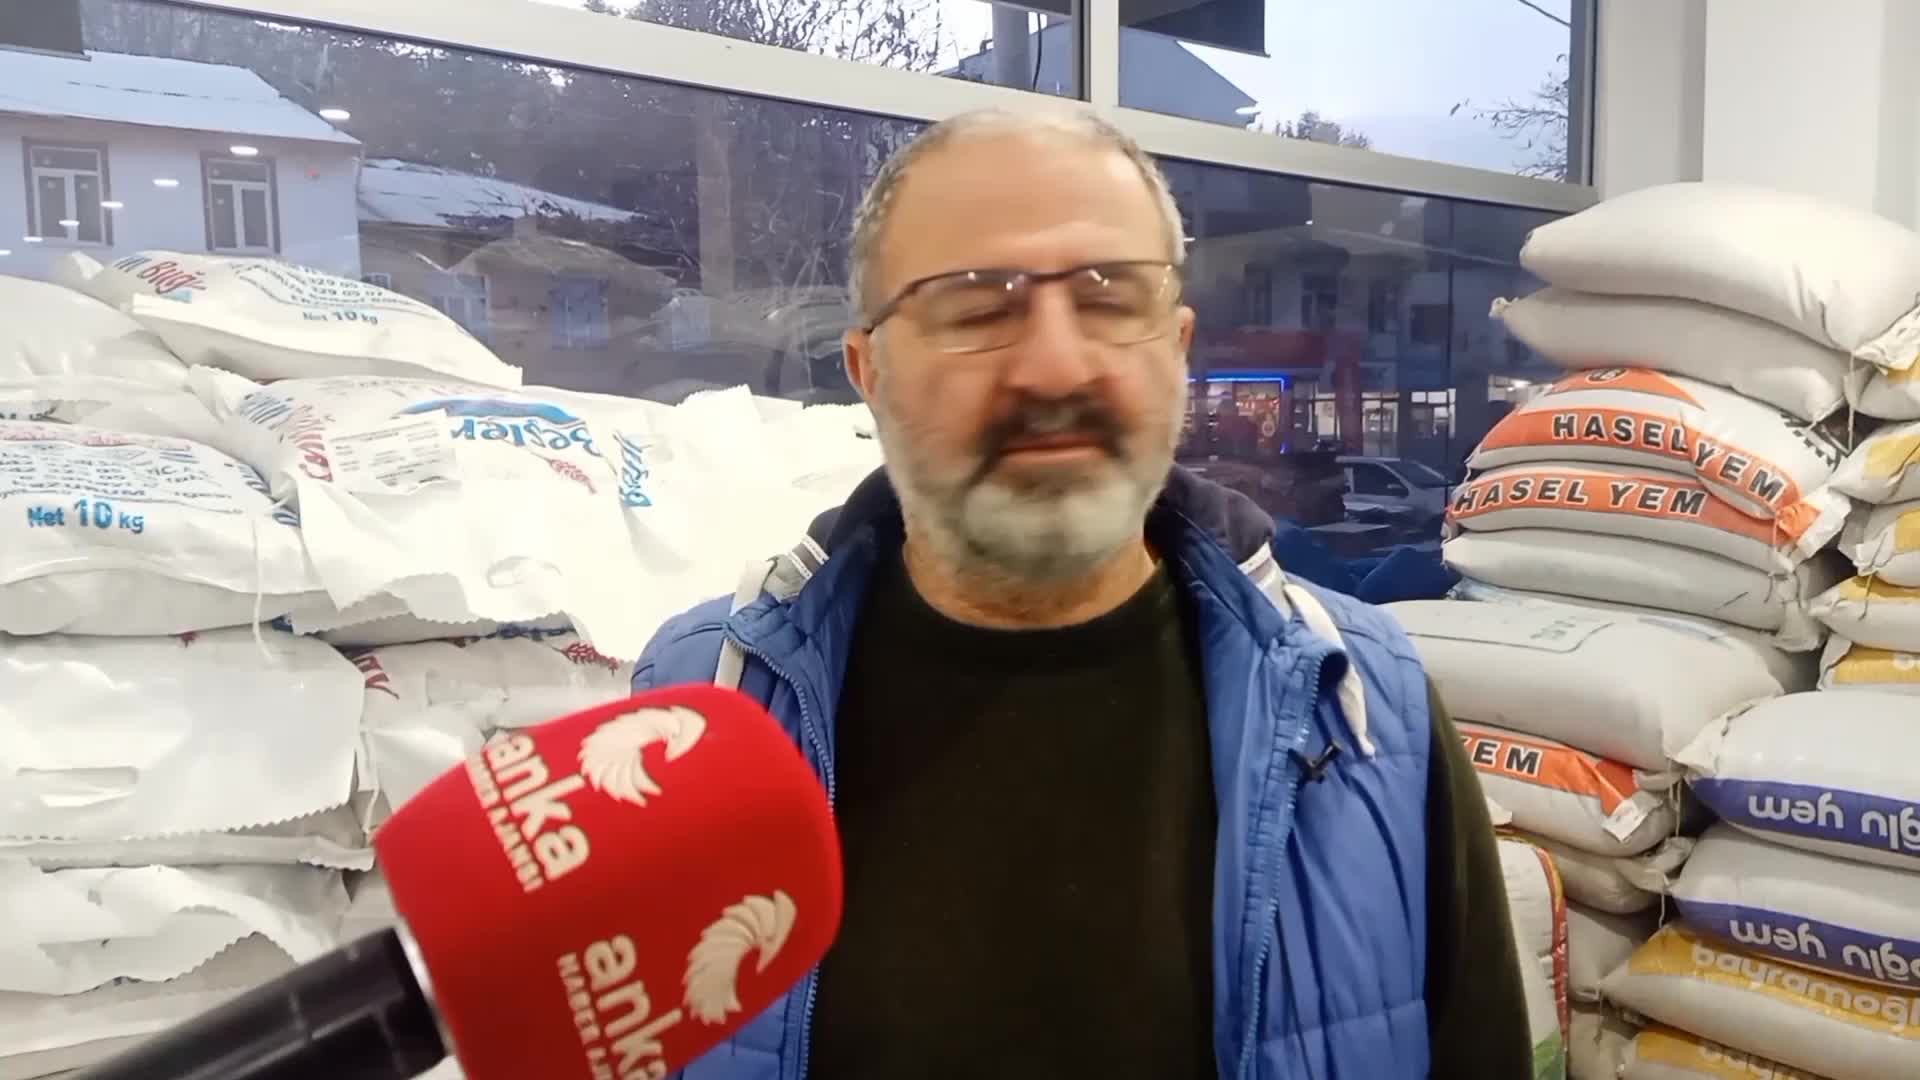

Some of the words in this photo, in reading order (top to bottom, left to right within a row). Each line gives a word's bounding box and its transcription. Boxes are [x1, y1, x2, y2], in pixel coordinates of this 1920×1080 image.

[332, 310, 358, 321] 10
[361, 313, 379, 326] kg
[1552, 413, 1690, 454] HASEL
[1694, 440, 1786, 503] YEM
[27, 506, 65, 528] Net
[73, 498, 113, 529] 10
[118, 511, 145, 534] kg
[1453, 477, 1588, 514] HASEL
[1609, 481, 1707, 516] YEM
[1461, 735, 1544, 778] EM
[482, 731, 591, 881] anka
[1749, 791, 1845, 830] yem
[1729, 917, 1827, 959] yem
